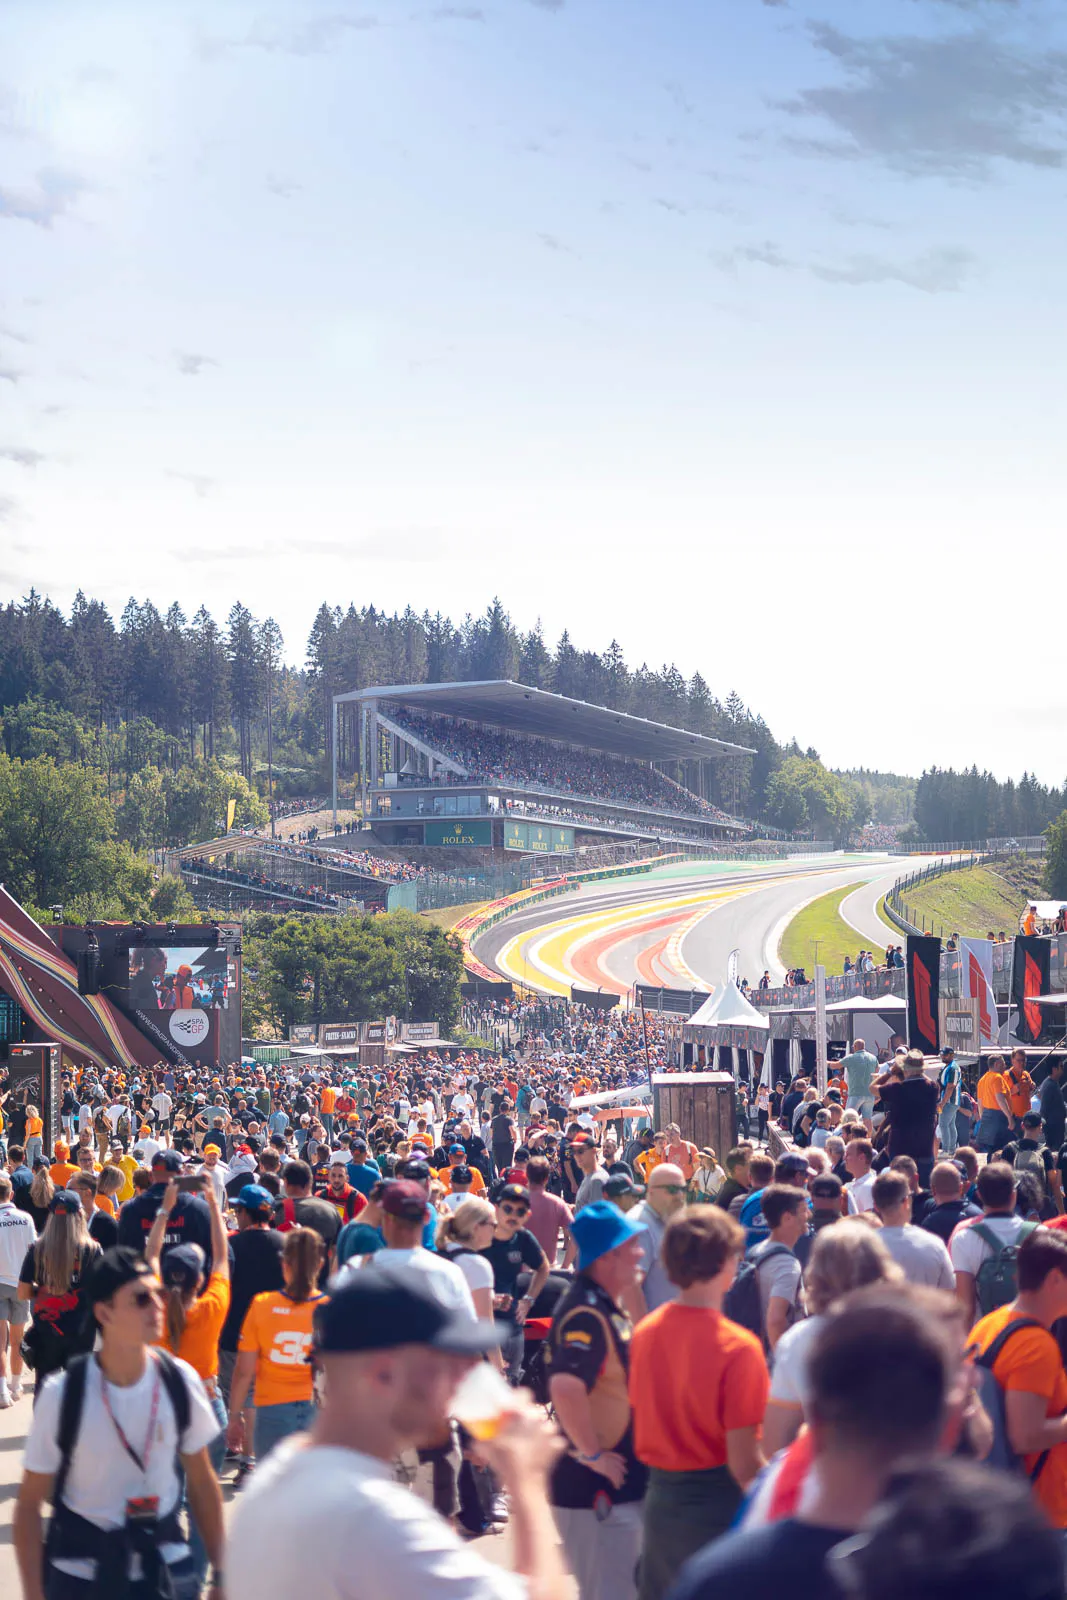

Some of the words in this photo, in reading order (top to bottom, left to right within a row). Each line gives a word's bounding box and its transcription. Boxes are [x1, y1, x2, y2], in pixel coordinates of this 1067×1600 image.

[442, 836, 475, 844] ROLEX
[508, 838, 525, 849] ROLEX
[532, 841, 548, 851] ROLEX
[191, 1025, 204, 1034] GP
